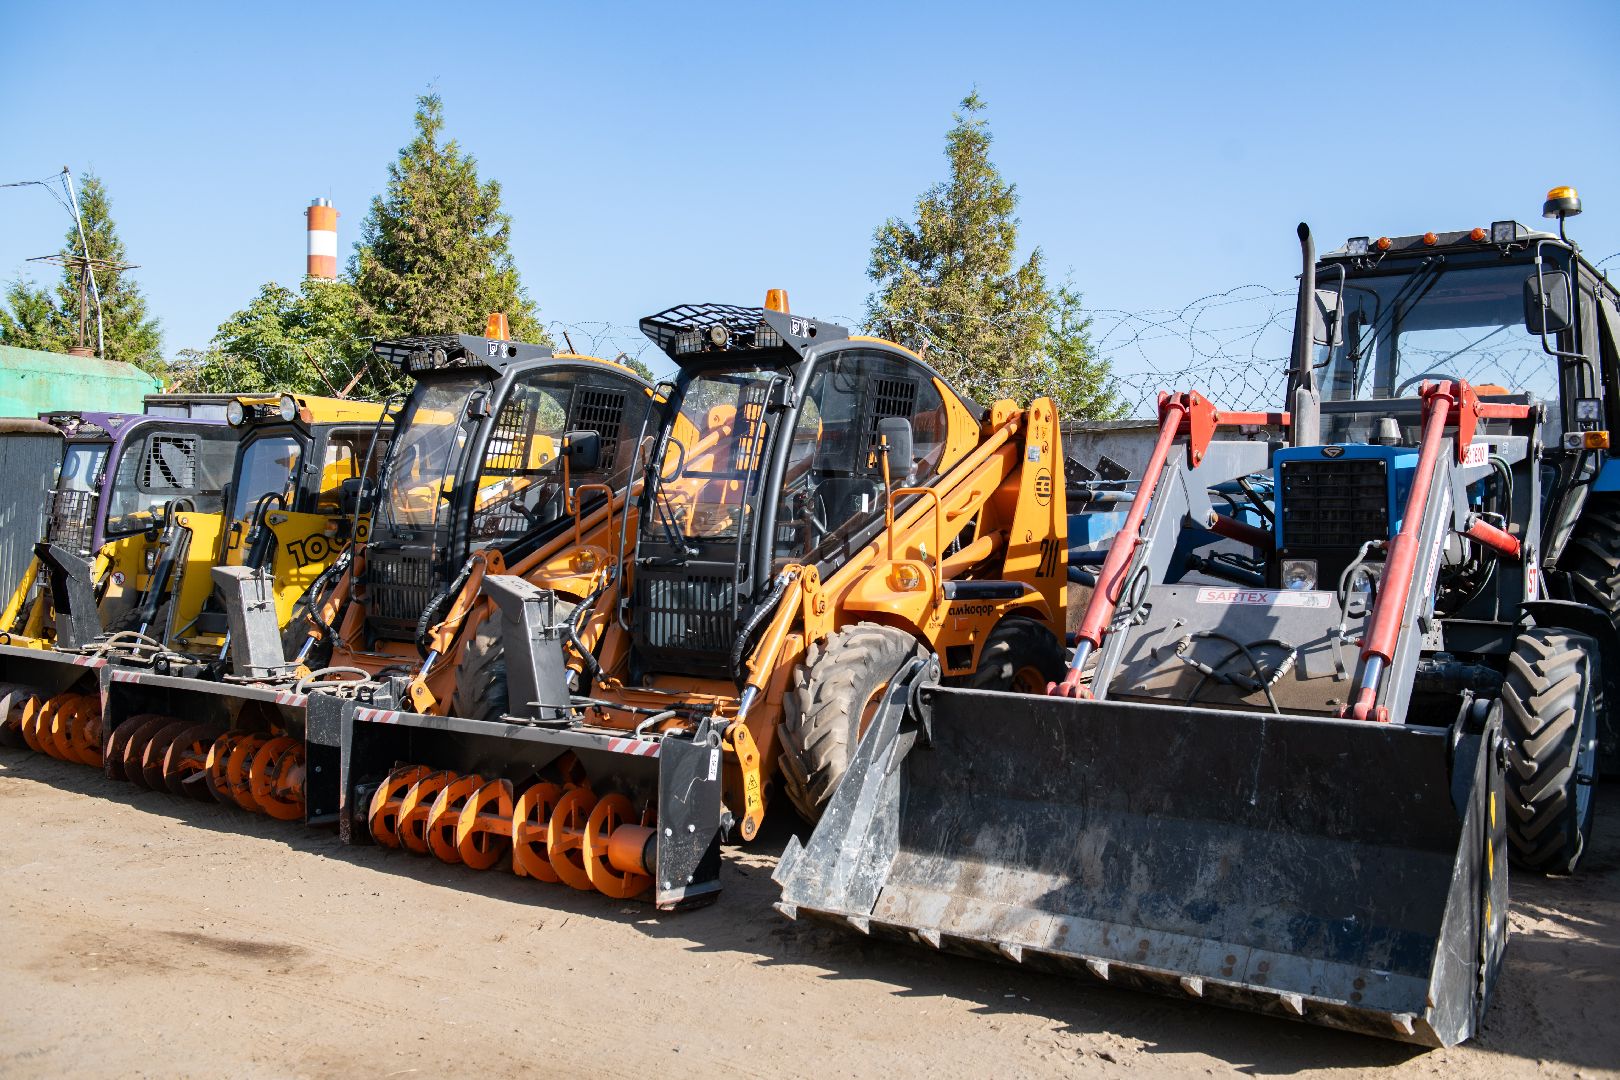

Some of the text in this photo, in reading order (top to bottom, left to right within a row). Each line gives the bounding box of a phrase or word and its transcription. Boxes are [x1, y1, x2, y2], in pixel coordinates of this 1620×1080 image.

[1035, 538, 1060, 578] 211
[1528, 568, 1537, 594] ST
[1206, 590, 1269, 603] SARTEX
